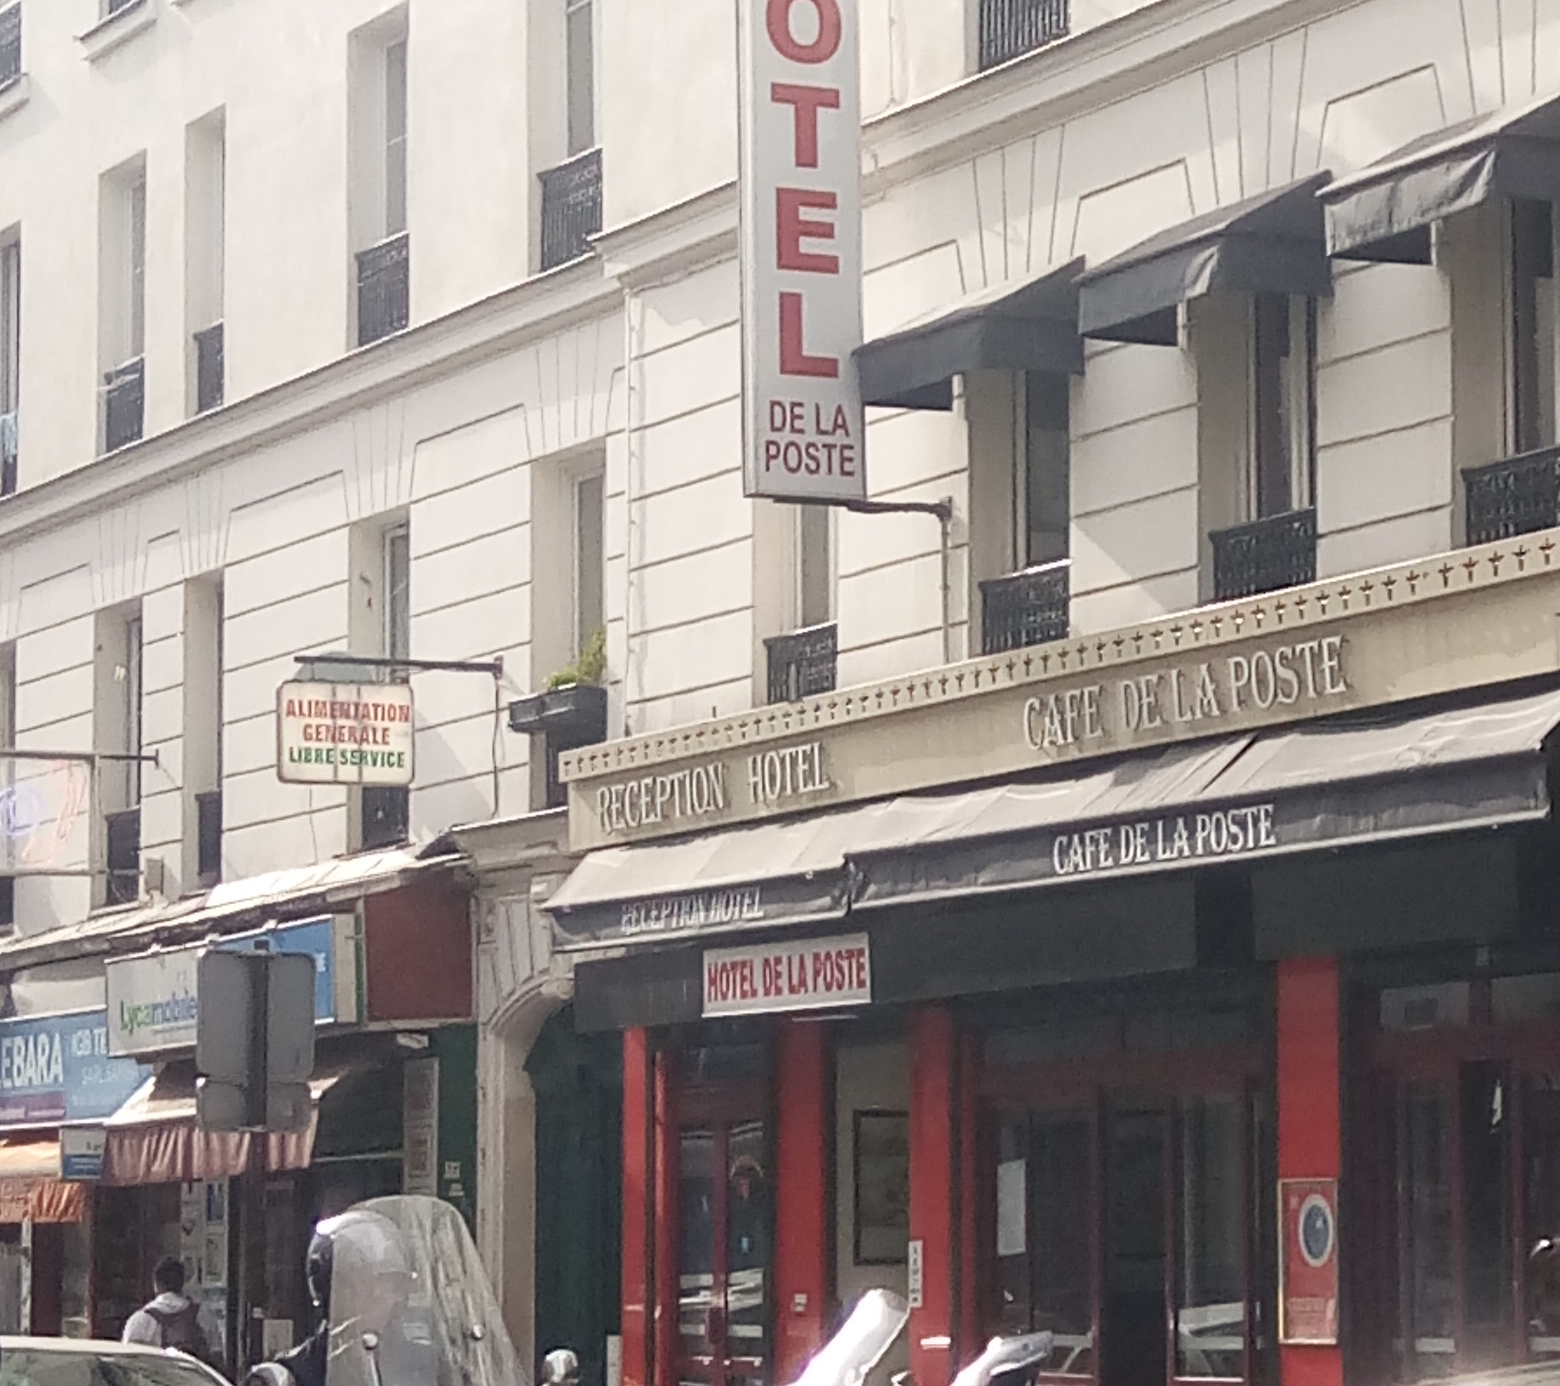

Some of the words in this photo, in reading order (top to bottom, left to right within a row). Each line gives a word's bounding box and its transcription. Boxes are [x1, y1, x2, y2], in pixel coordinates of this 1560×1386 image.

[769, 399, 804, 435] DE
[815, 402, 850, 437] LA
[764, 440, 855, 477] POSTE
[285, 699, 410, 723] ALIMENTATION
[1022, 684, 1104, 751] CAFE
[1120, 673, 1162, 731] DE
[1171, 661, 1221, 723] LA
[1228, 634, 1347, 713] POSTE
[289, 746, 335, 764] LIBRE
[339, 749, 406, 769] SERVICE
[303, 724, 390, 746] GENERALE
[596, 763, 725, 835] RECEPTION
[748, 741, 830, 804] HOTEL
[1052, 827, 1114, 875] CAFE
[1119, 822, 1151, 864] DE
[1156, 817, 1191, 861] LA
[1195, 804, 1277, 855] POSTE
[620, 892, 705, 936] RECEPTION
[710, 886, 764, 924] HOTEL
[707, 958, 758, 1003] HOTEL
[762, 955, 783, 997] DE
[787, 953, 808, 995] LA
[812, 947, 866, 993] POSTE
[0, 1032, 64, 1089] EBARA
